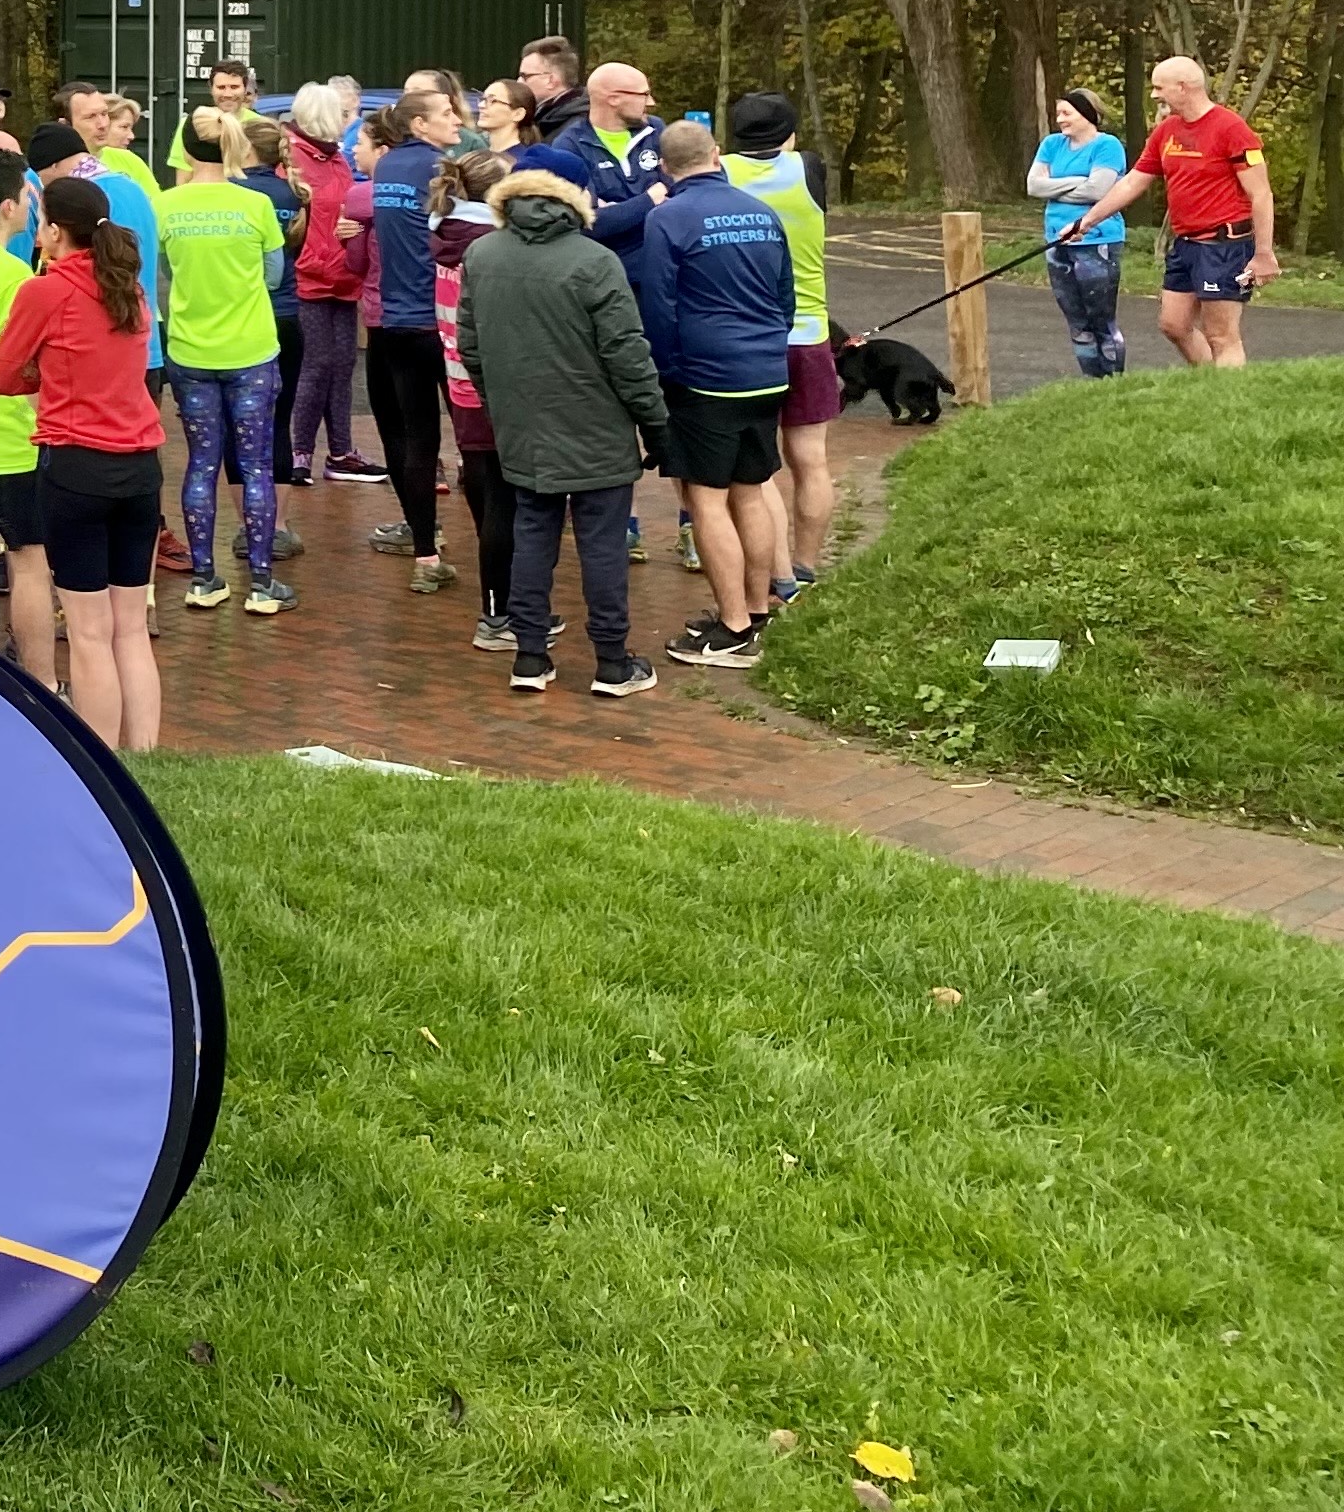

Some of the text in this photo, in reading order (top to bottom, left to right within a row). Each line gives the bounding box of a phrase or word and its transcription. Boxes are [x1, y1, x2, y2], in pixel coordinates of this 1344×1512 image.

[167, 210, 245, 225] STOCKTON
[703, 213, 773, 230] STOCKTON
[701, 228, 767, 248] STRIDERS
